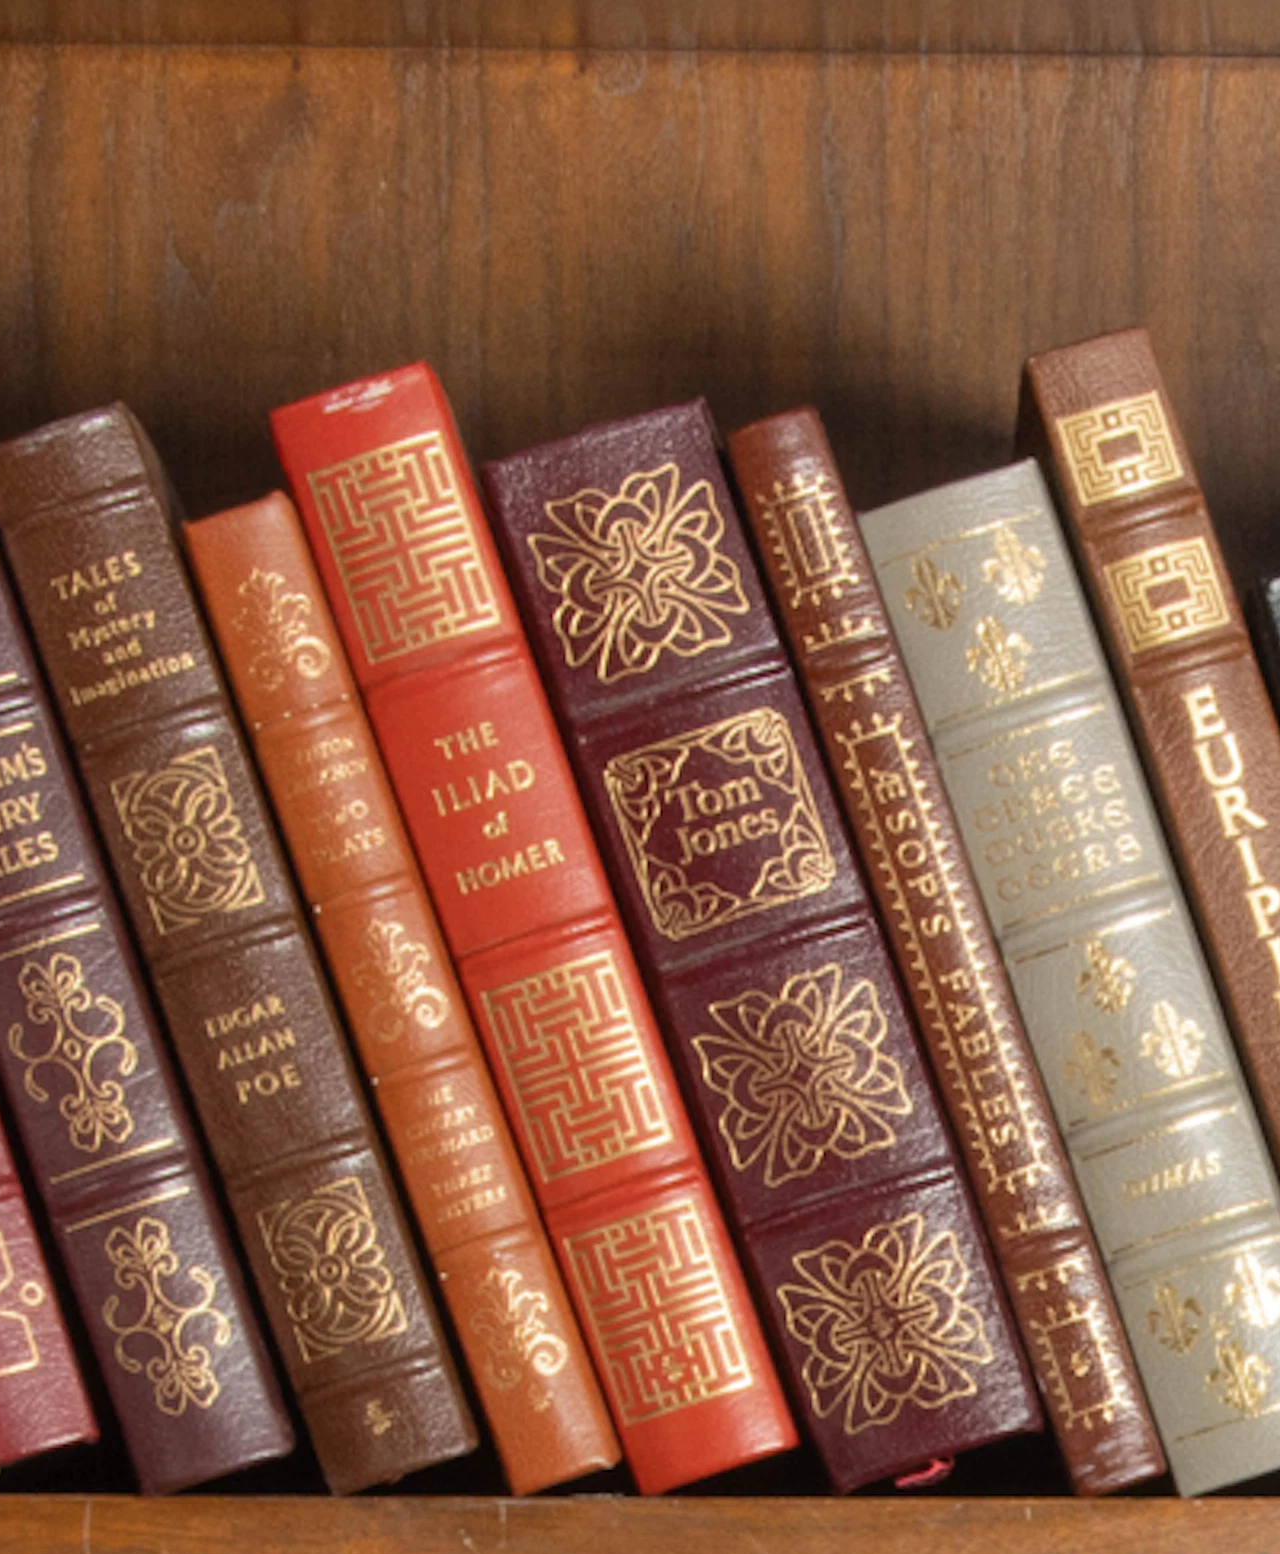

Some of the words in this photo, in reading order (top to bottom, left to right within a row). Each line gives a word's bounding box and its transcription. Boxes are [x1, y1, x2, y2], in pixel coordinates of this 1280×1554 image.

[51, 550, 143, 600] TALES
[94, 593, 118, 615] of
[67, 610, 156, 650] Mystery
[103, 639, 142, 666] and
[71, 652, 196, 707] Imagination
[434, 721, 500, 760] THE
[431, 760, 536, 816] ILIAD
[664, 774, 762, 822] Tom
[483, 811, 510, 840] of
[675, 807, 782, 865] Jones
[456, 839, 566, 895] HOMER
[204, 996, 286, 1039] EDGAR
[218, 1027, 297, 1070] ALLAN
[939, 971, 1021, 1149] FABLES
[236, 1064, 301, 1104] POE
